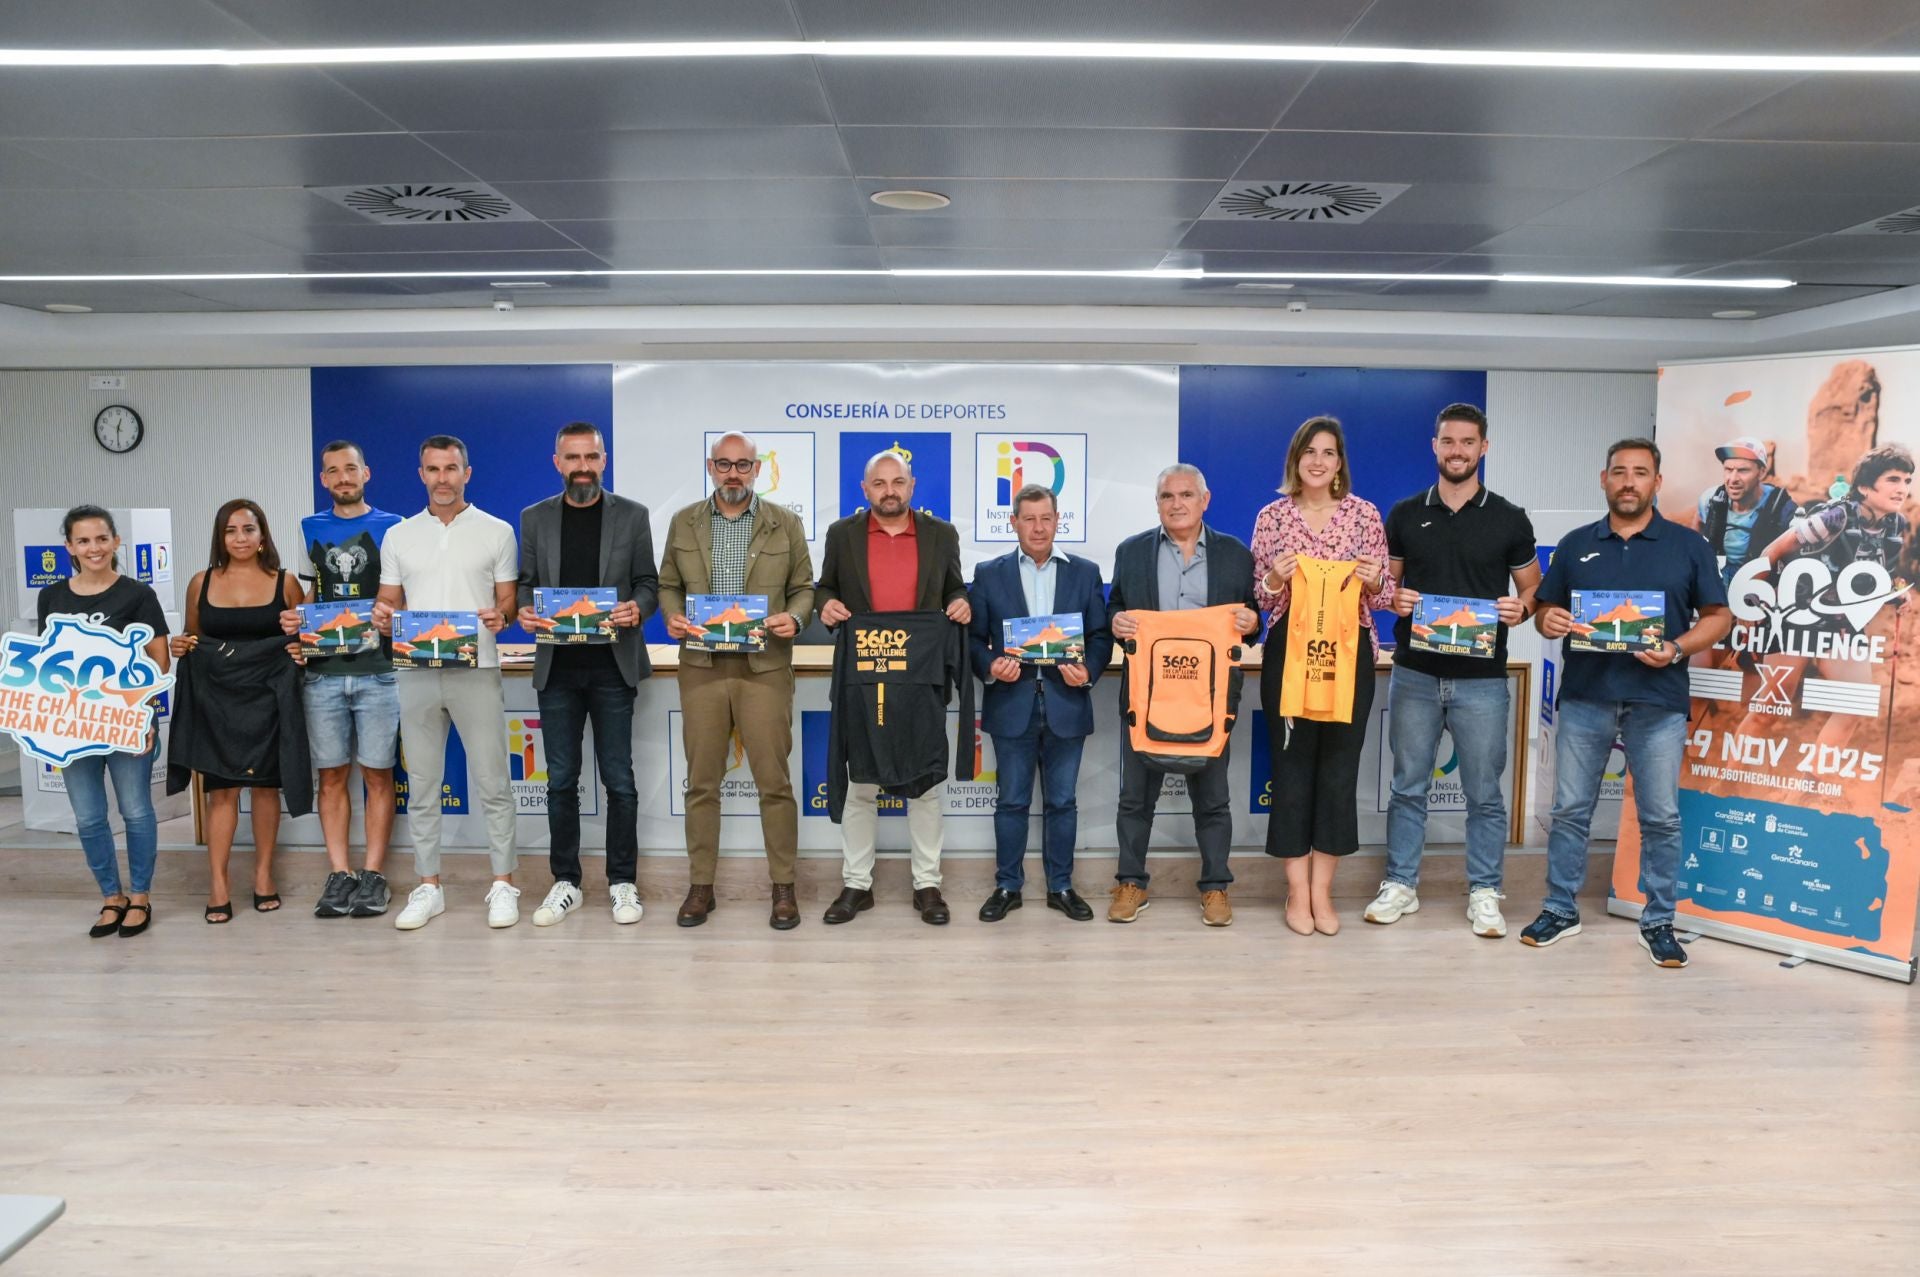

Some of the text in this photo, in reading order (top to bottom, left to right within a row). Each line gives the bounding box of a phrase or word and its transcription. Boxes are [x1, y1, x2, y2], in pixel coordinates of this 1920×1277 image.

[785, 401, 1006, 419] CONSEJERÍA DE DEPORTES
[572, 612, 580, 634] 1
[722, 620, 730, 642] 1
[1449, 622, 1458, 645] 1
[1612, 618, 1621, 642] 1
[336, 625, 344, 646] 1
[567, 634, 587, 642] JAVIER
[430, 636, 439, 659] 1
[857, 649, 907, 657] THE CHALLENGE
[1040, 640, 1048, 658] 1
[1438, 644, 1471, 654] FREDERICK
[1606, 642, 1627, 651] RAYCO
[428, 659, 443, 667] LUIS
[0, 688, 147, 729] THE CHALLENGE
[1749, 702, 1792, 716] EDICIÓN
[53, 717, 141, 748] CANARIA
[1721, 731, 1788, 768] NOV
[1797, 742, 1884, 781] 2025
[947, 784, 992, 795] INSTITUTO
[1691, 763, 1842, 797] WWW.360THECHALLENGE.COM
